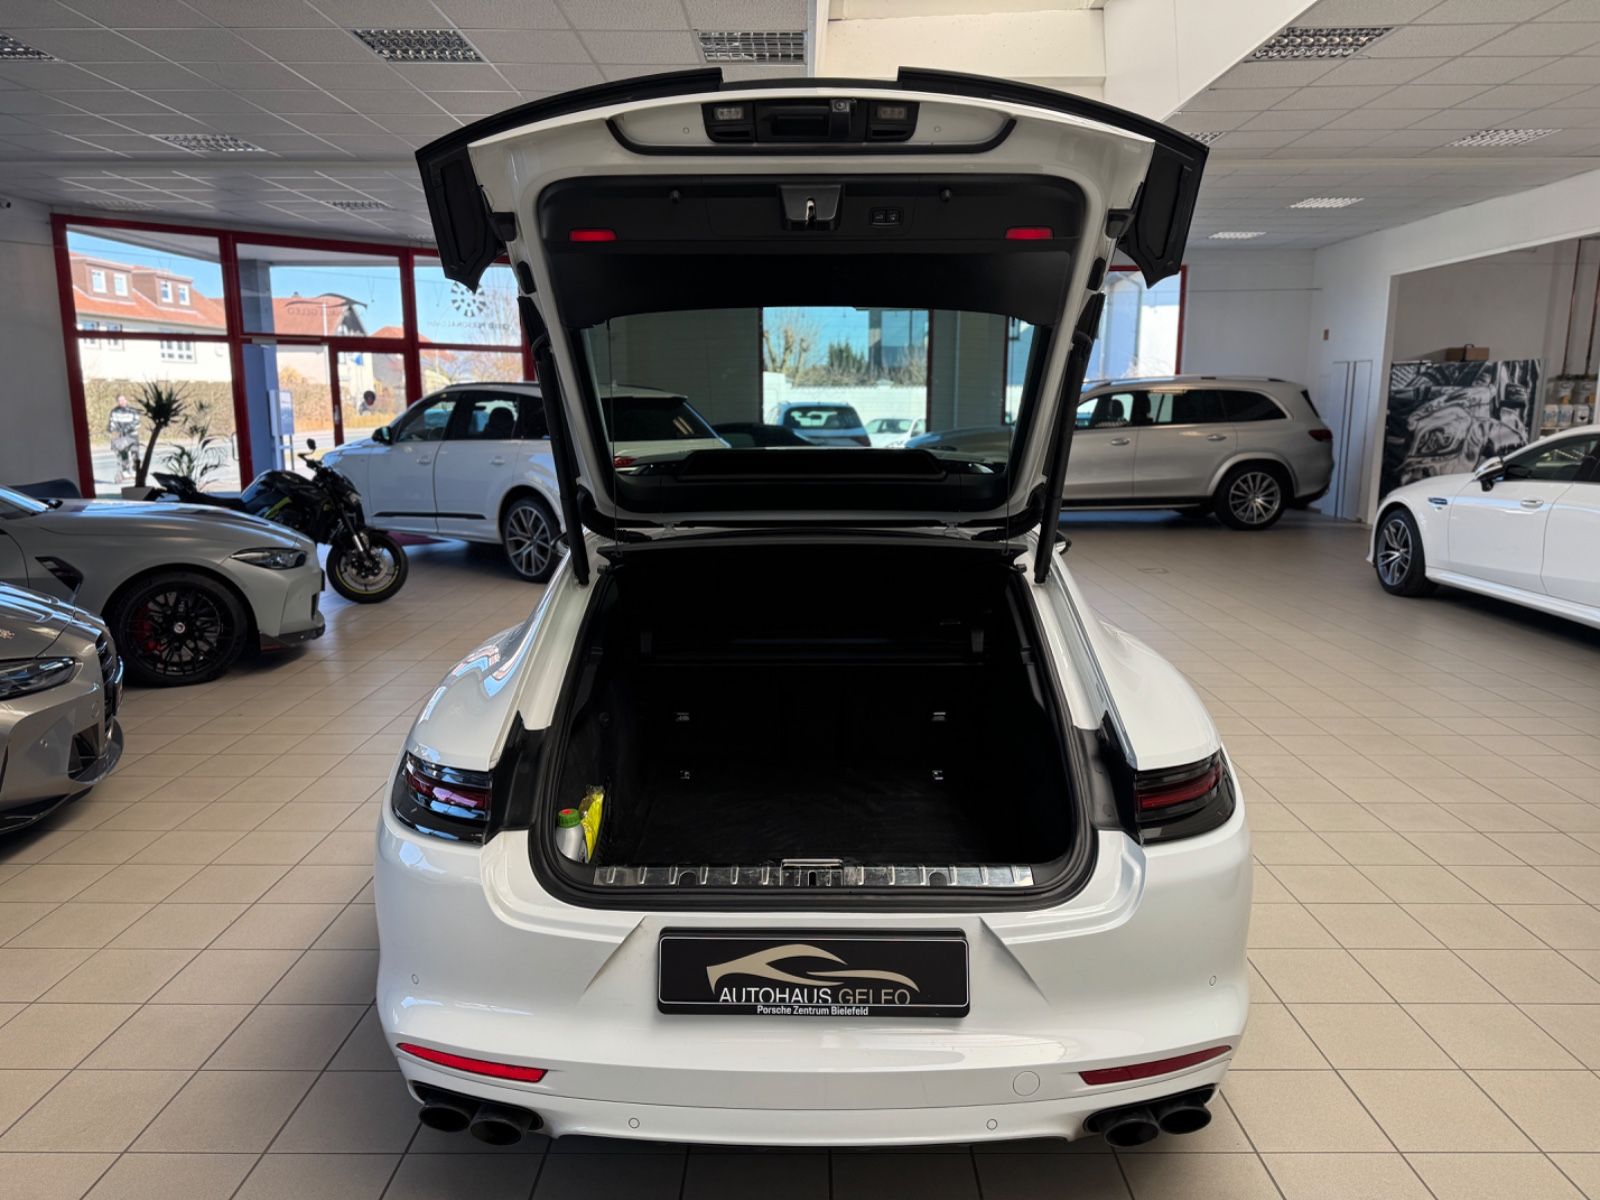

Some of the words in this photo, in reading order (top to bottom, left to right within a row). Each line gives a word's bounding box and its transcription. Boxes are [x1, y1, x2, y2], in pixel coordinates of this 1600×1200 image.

[720, 987, 832, 1003] AUTOHAUS
[757, 1005, 791, 1014] Porsche
[793, 1005, 829, 1015] Zentrum
[831, 1006, 868, 1015] Bielefeld
